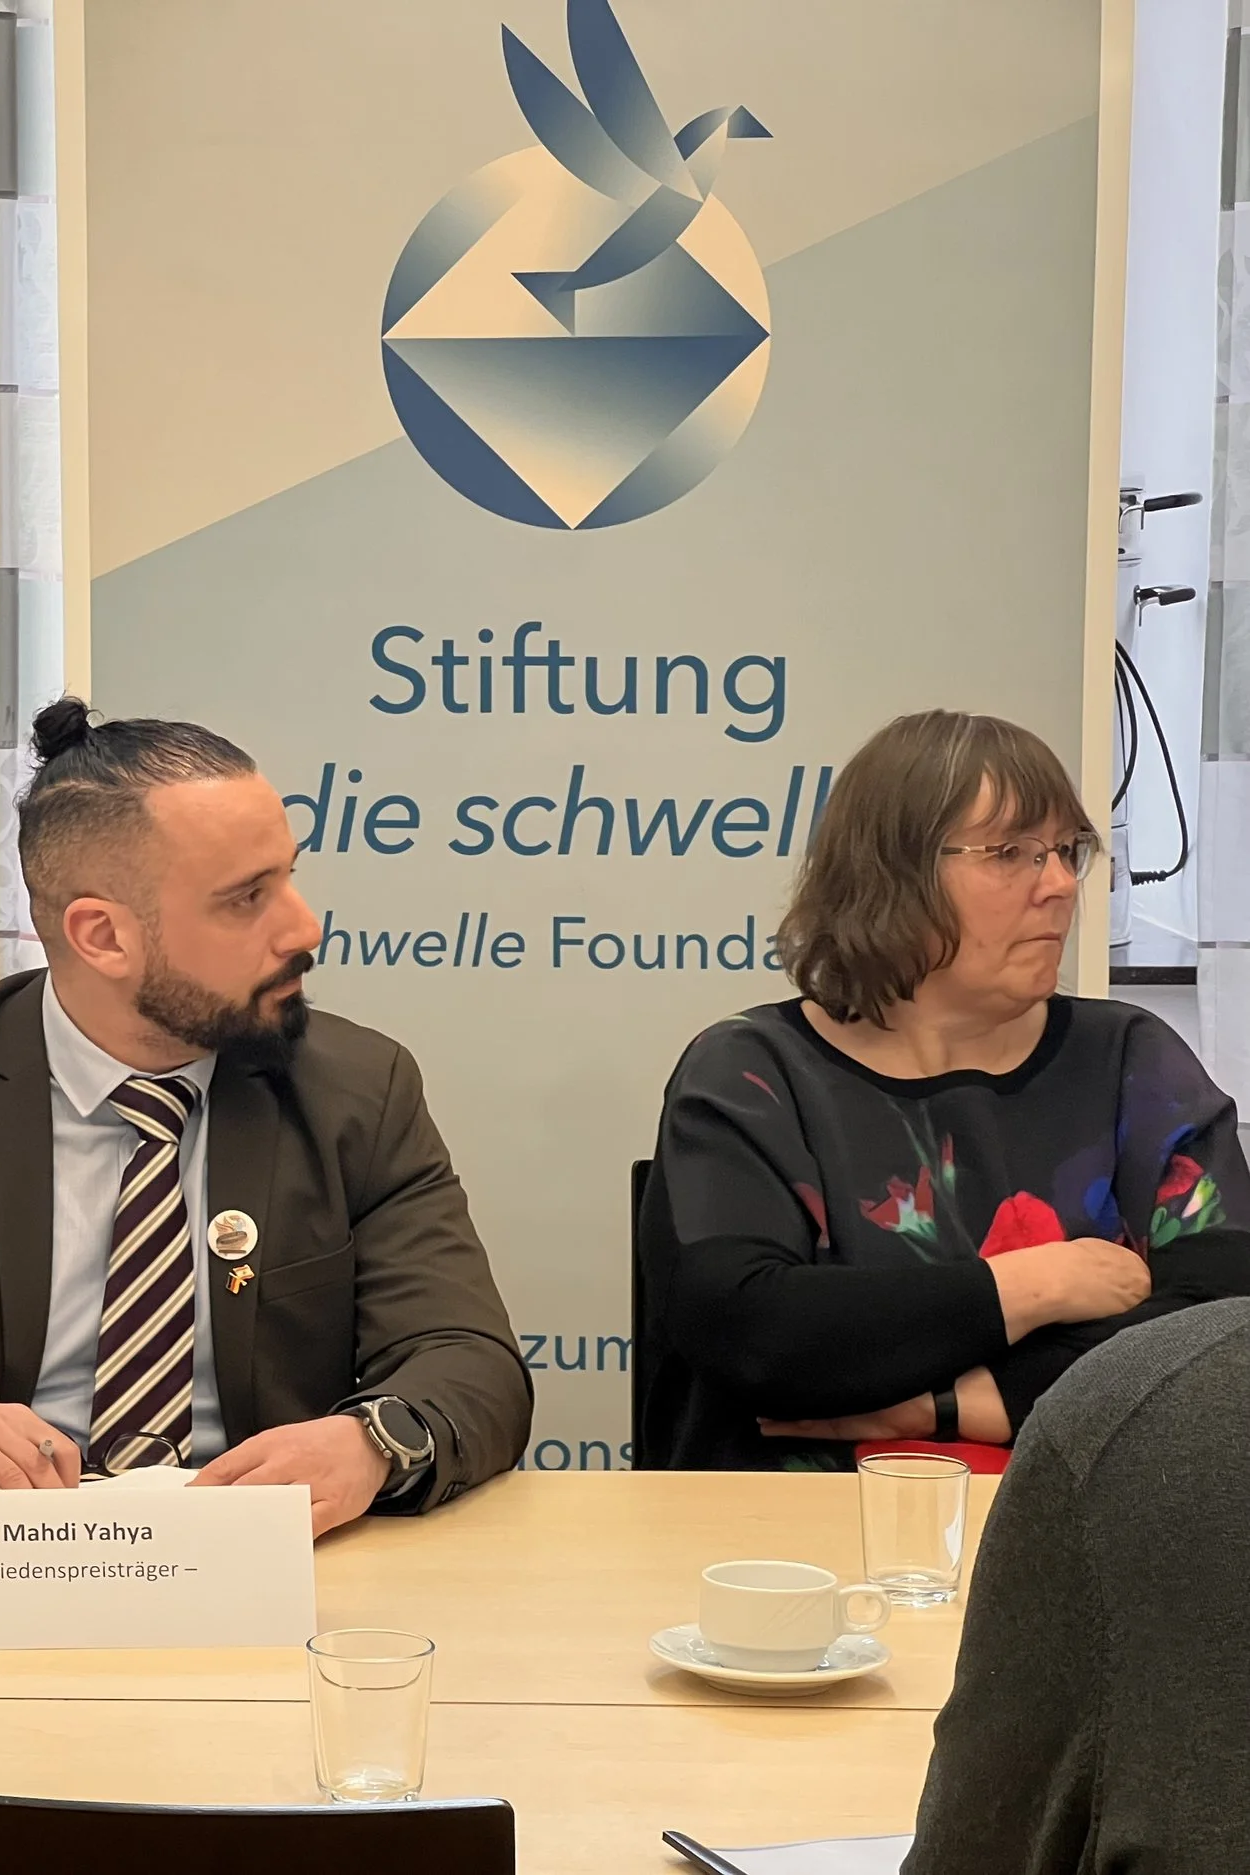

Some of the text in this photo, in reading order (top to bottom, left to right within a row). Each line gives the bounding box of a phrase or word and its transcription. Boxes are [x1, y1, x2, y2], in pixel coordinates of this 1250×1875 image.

[369, 620, 786, 743] Stiftung
[281, 762, 834, 858] die schwell
[316, 910, 784, 971] hwelle Founda
[519, 1334, 632, 1372] zum
[3, 1521, 153, 1545] Mahdi Yahya
